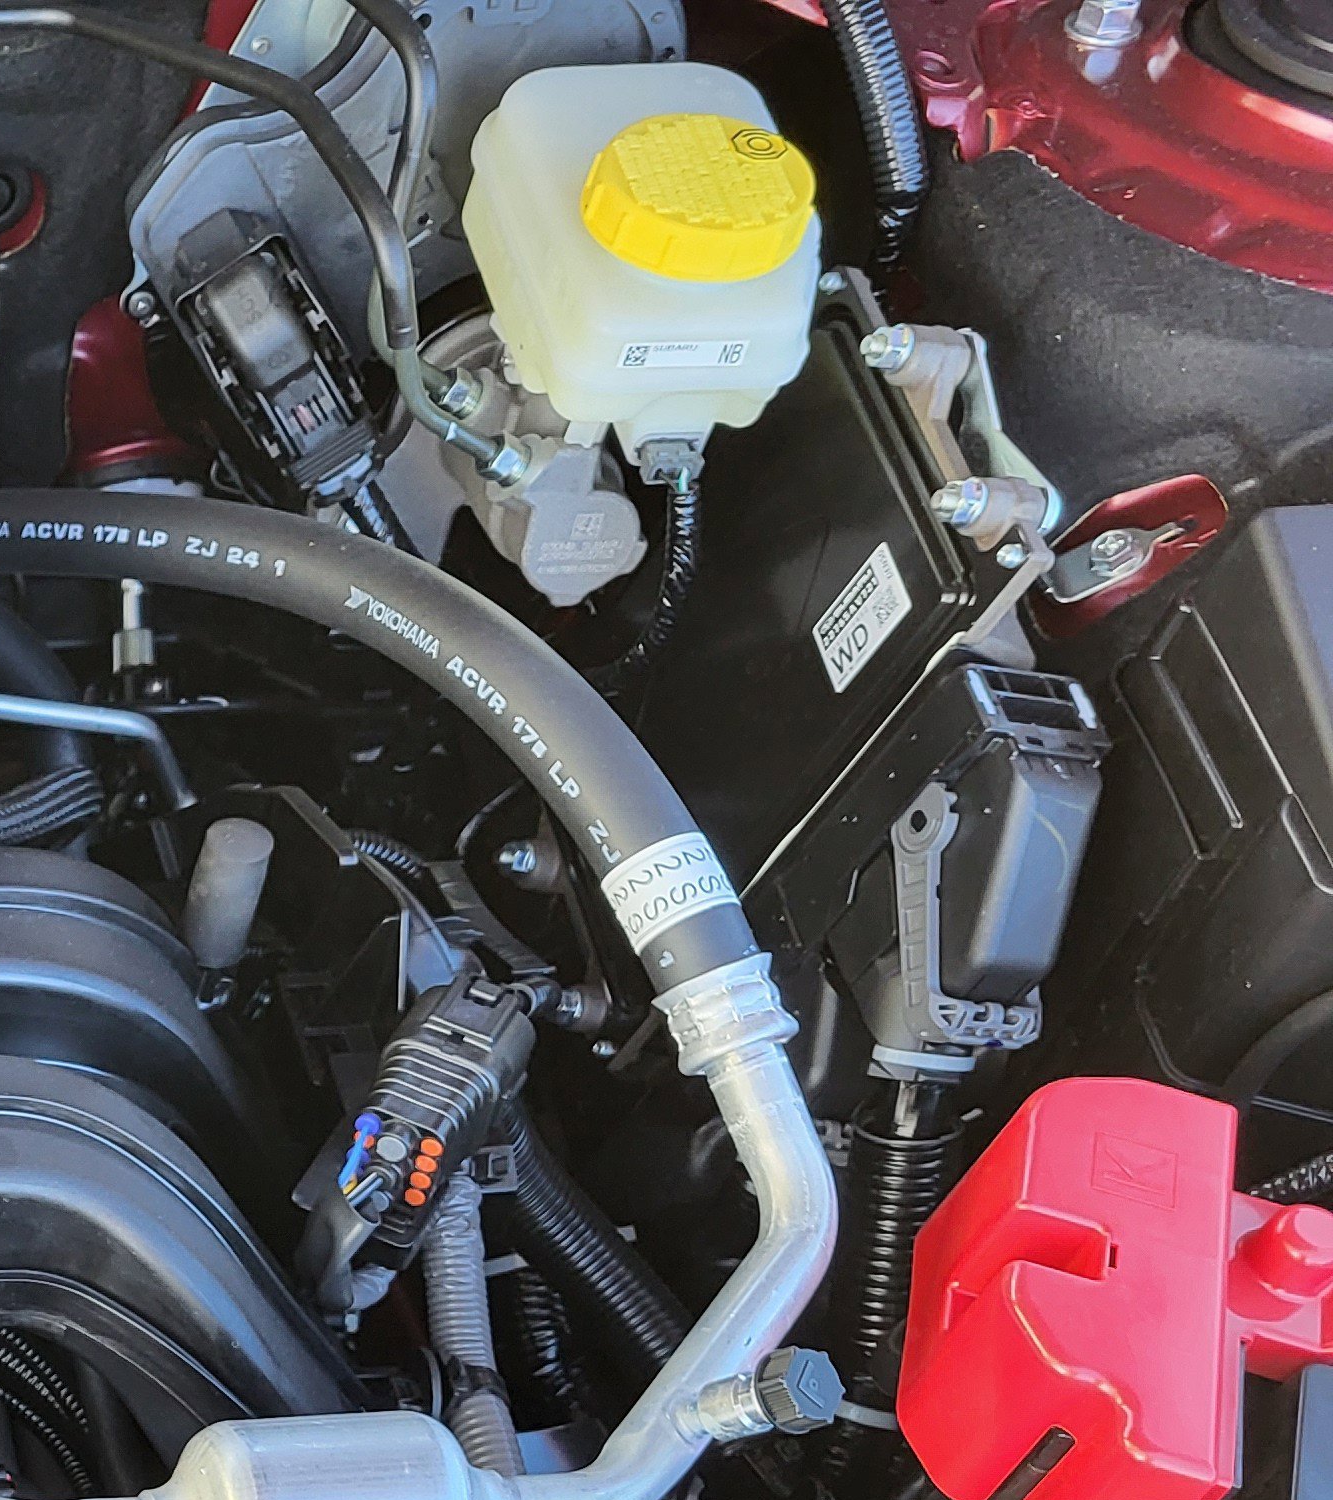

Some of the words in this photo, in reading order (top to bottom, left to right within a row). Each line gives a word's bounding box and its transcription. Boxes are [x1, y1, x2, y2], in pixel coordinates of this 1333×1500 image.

[717, 343, 744, 364] NB
[20, 521, 85, 542] ACVR
[136, 528, 171, 549] LP
[184, 535, 220, 558] ZJ
[225, 545, 262, 570] 24
[273, 558, 287, 578] 1
[830, 622, 870, 676] WD
[364, 593, 442, 661] YOKOHAMA
[445, 654, 509, 716] ACVR
[547, 759, 581, 800] LP
[587, 818, 624, 865] ZJ
